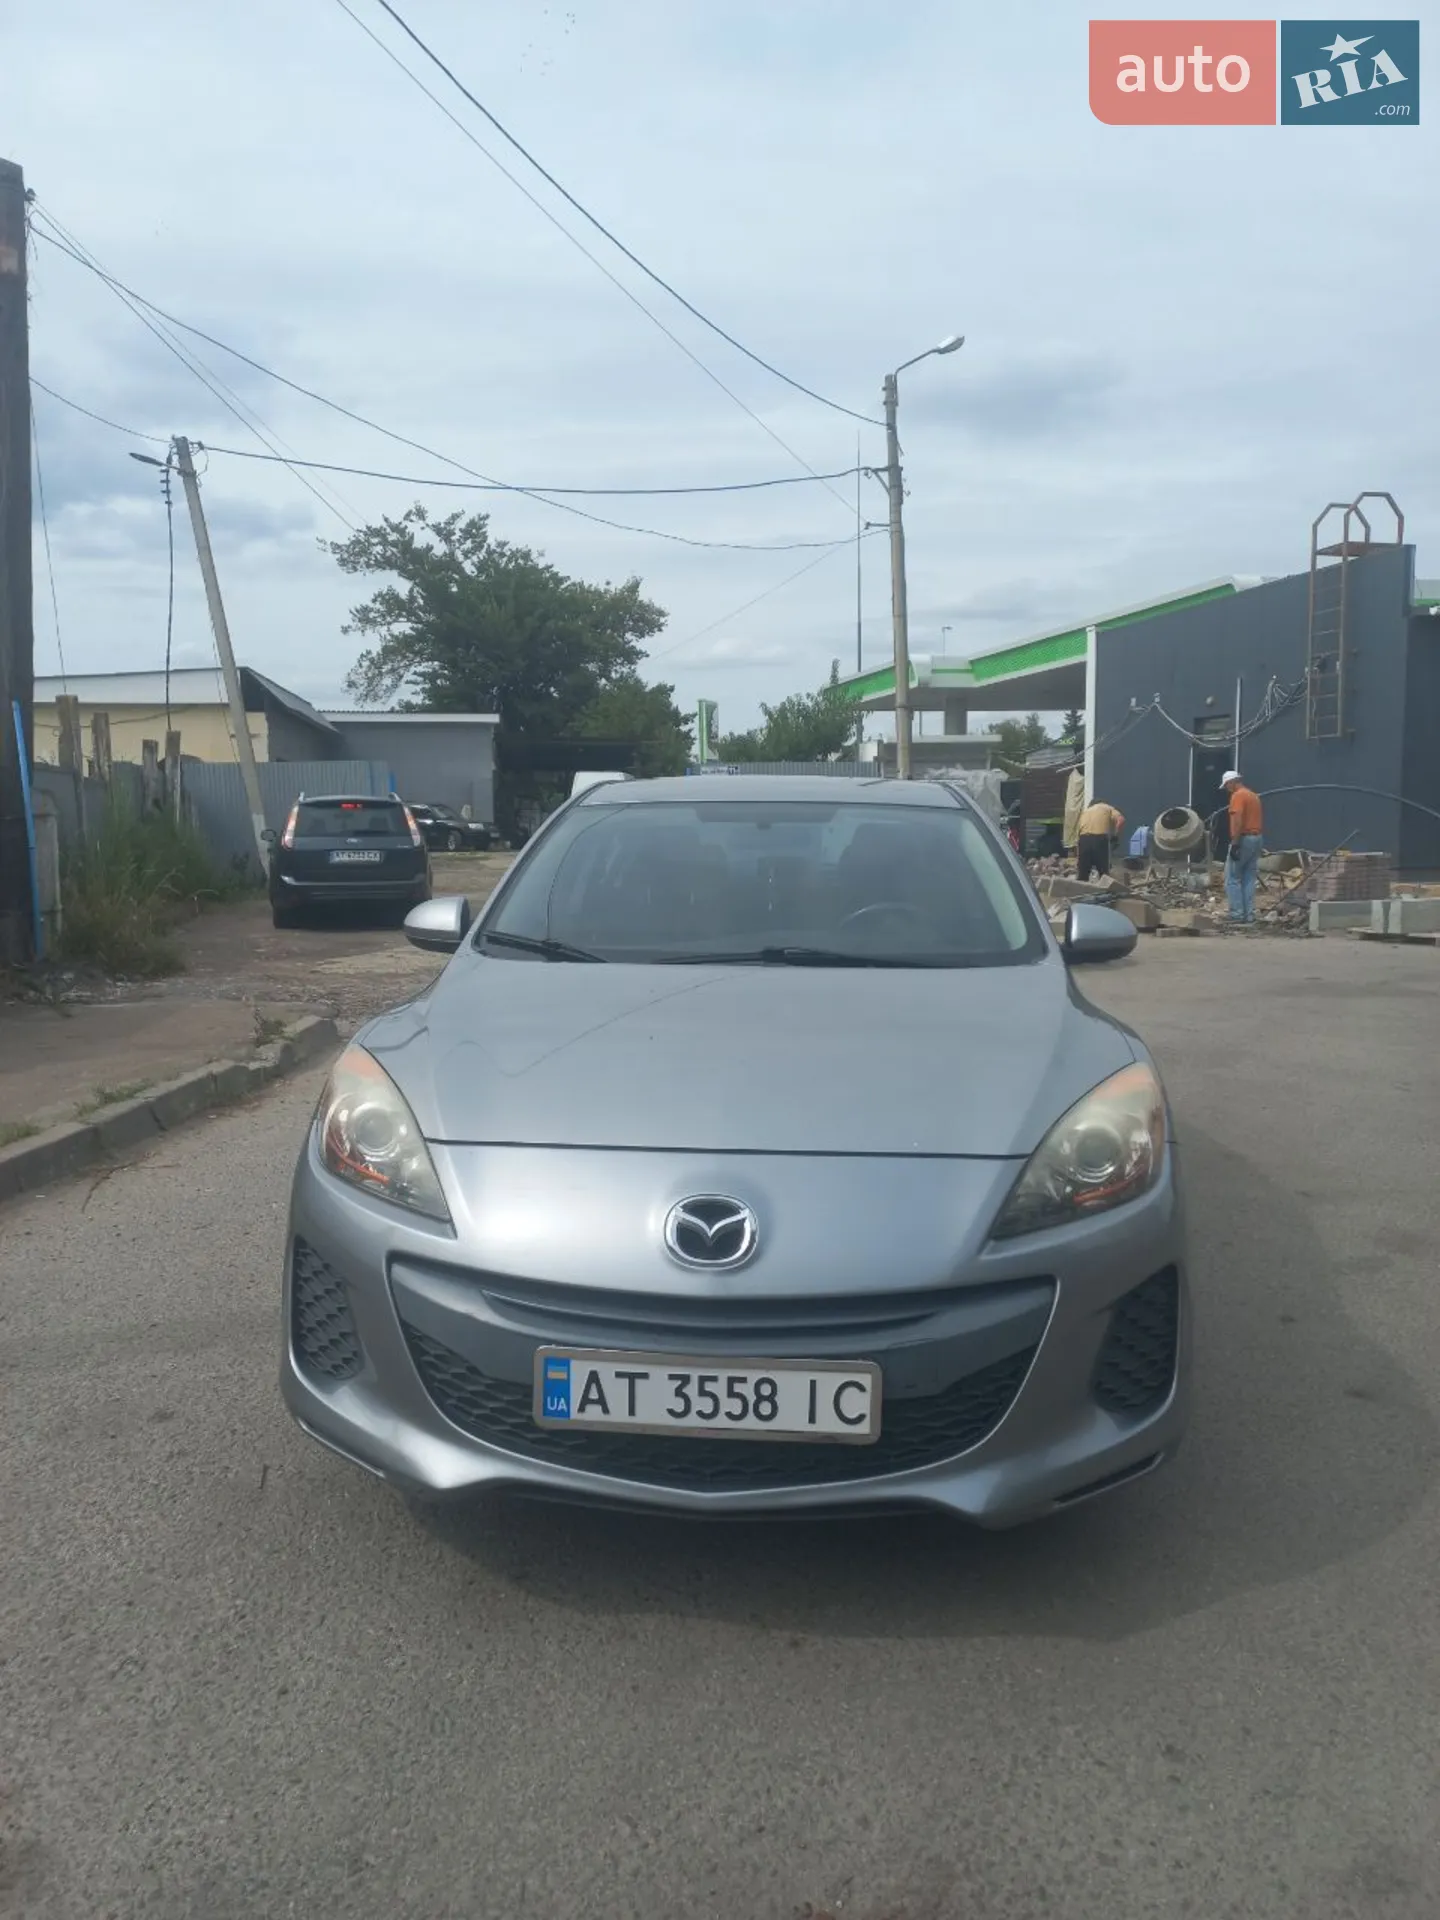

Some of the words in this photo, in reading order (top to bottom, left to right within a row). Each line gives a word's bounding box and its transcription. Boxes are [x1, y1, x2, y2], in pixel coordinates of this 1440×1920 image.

[547, 1395, 568, 1412] UA
[577, 1370, 649, 1417] AT
[666, 1373, 779, 1422] 3558
[808, 1379, 868, 1426] IC
